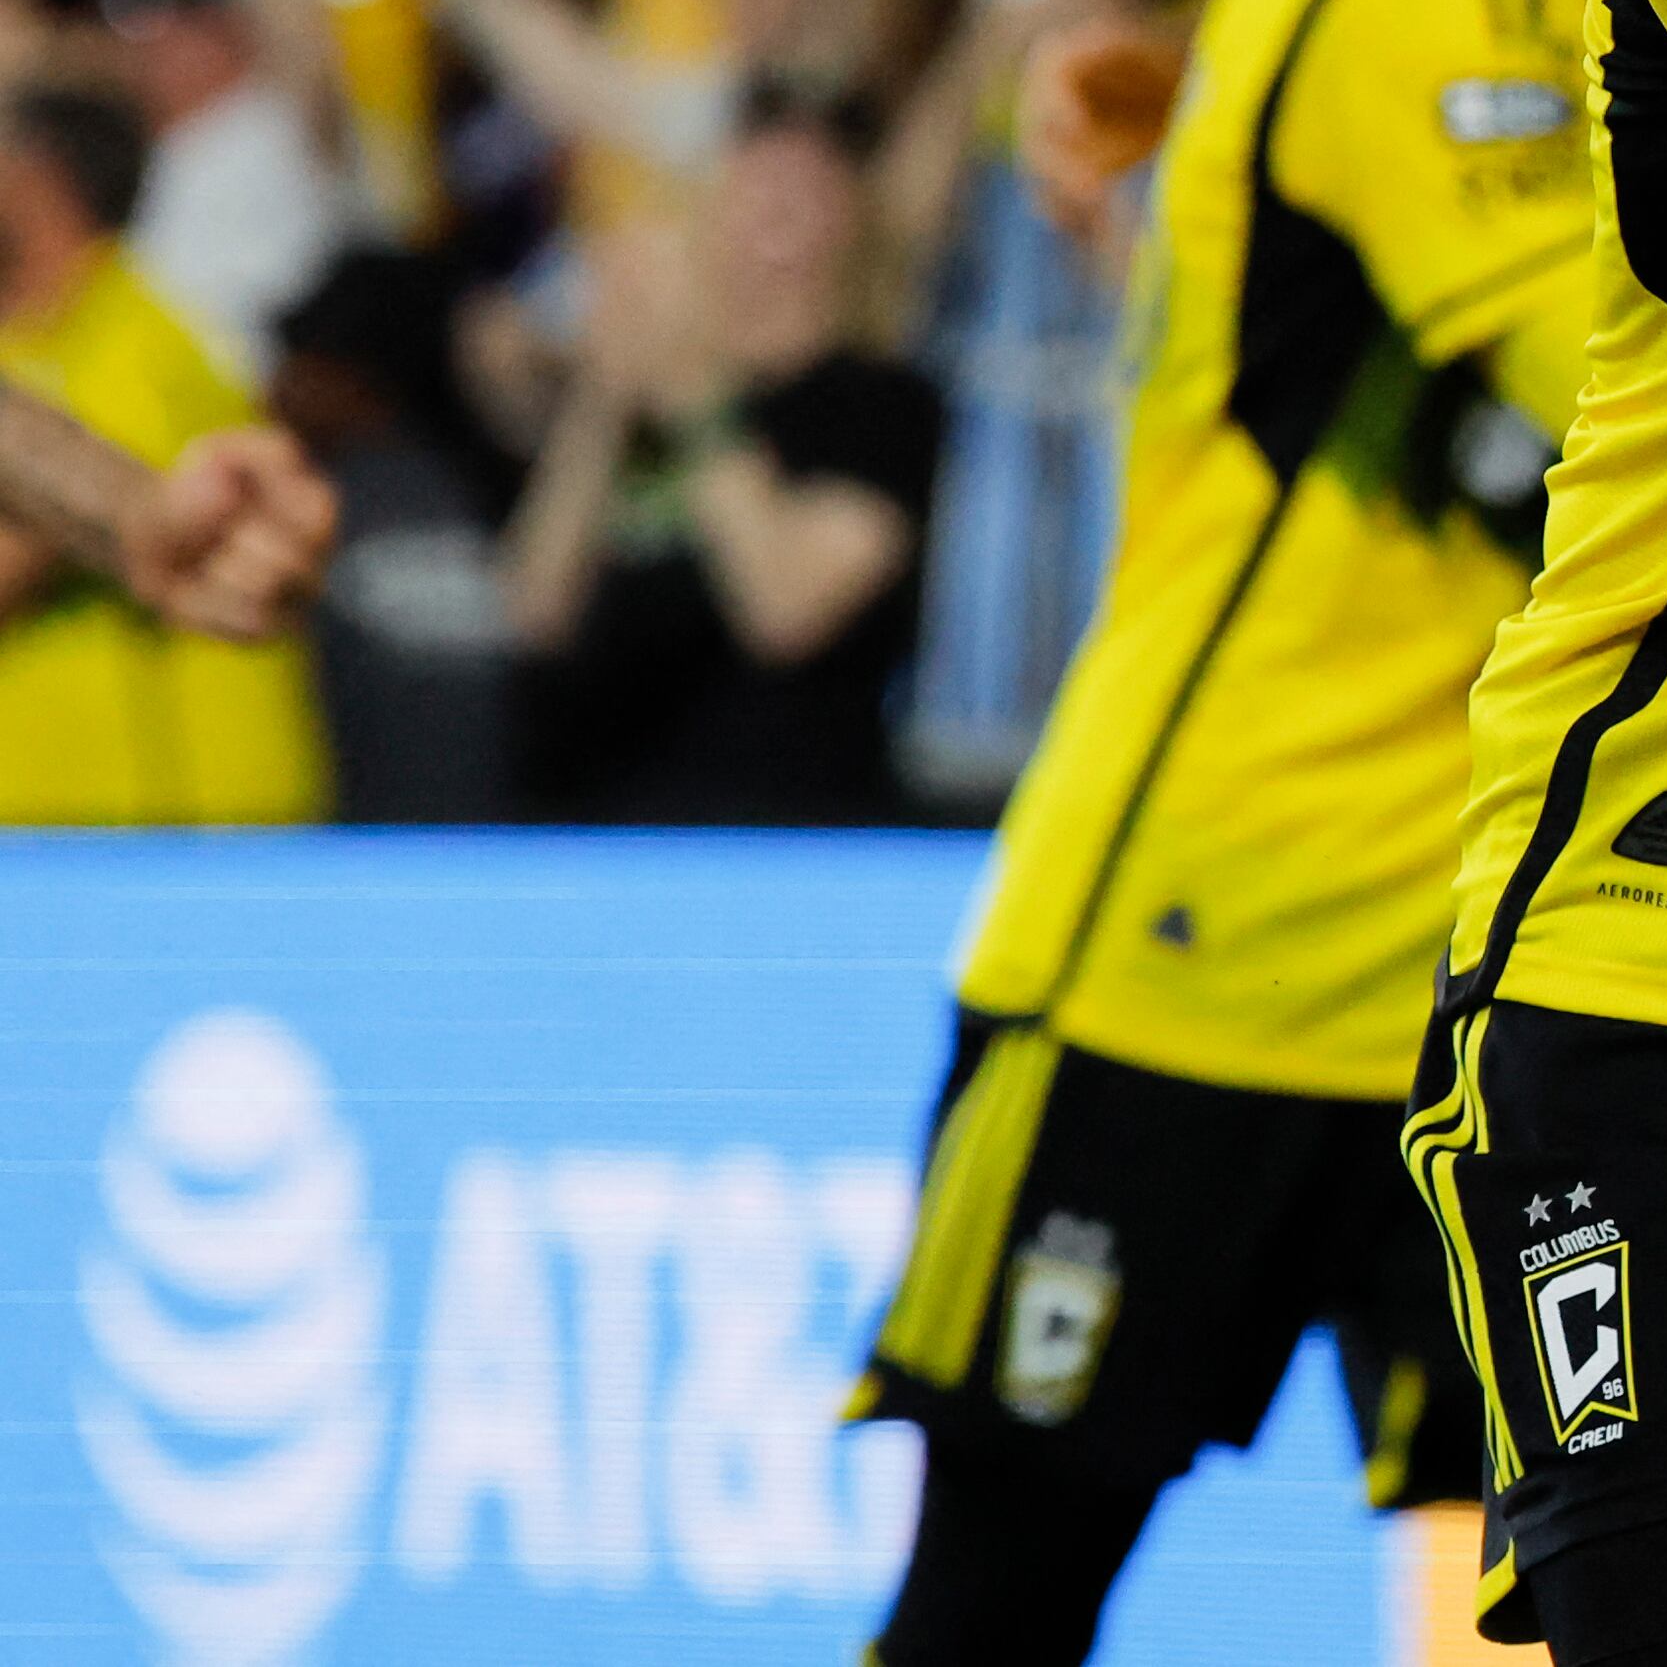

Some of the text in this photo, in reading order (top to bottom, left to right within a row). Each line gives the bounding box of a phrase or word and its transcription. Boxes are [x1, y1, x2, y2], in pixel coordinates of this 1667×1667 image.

[1519, 1218, 1621, 1273] COLUMBUS
[1602, 1378, 1625, 1401] 96
[1567, 1421, 1625, 1455] CREW
